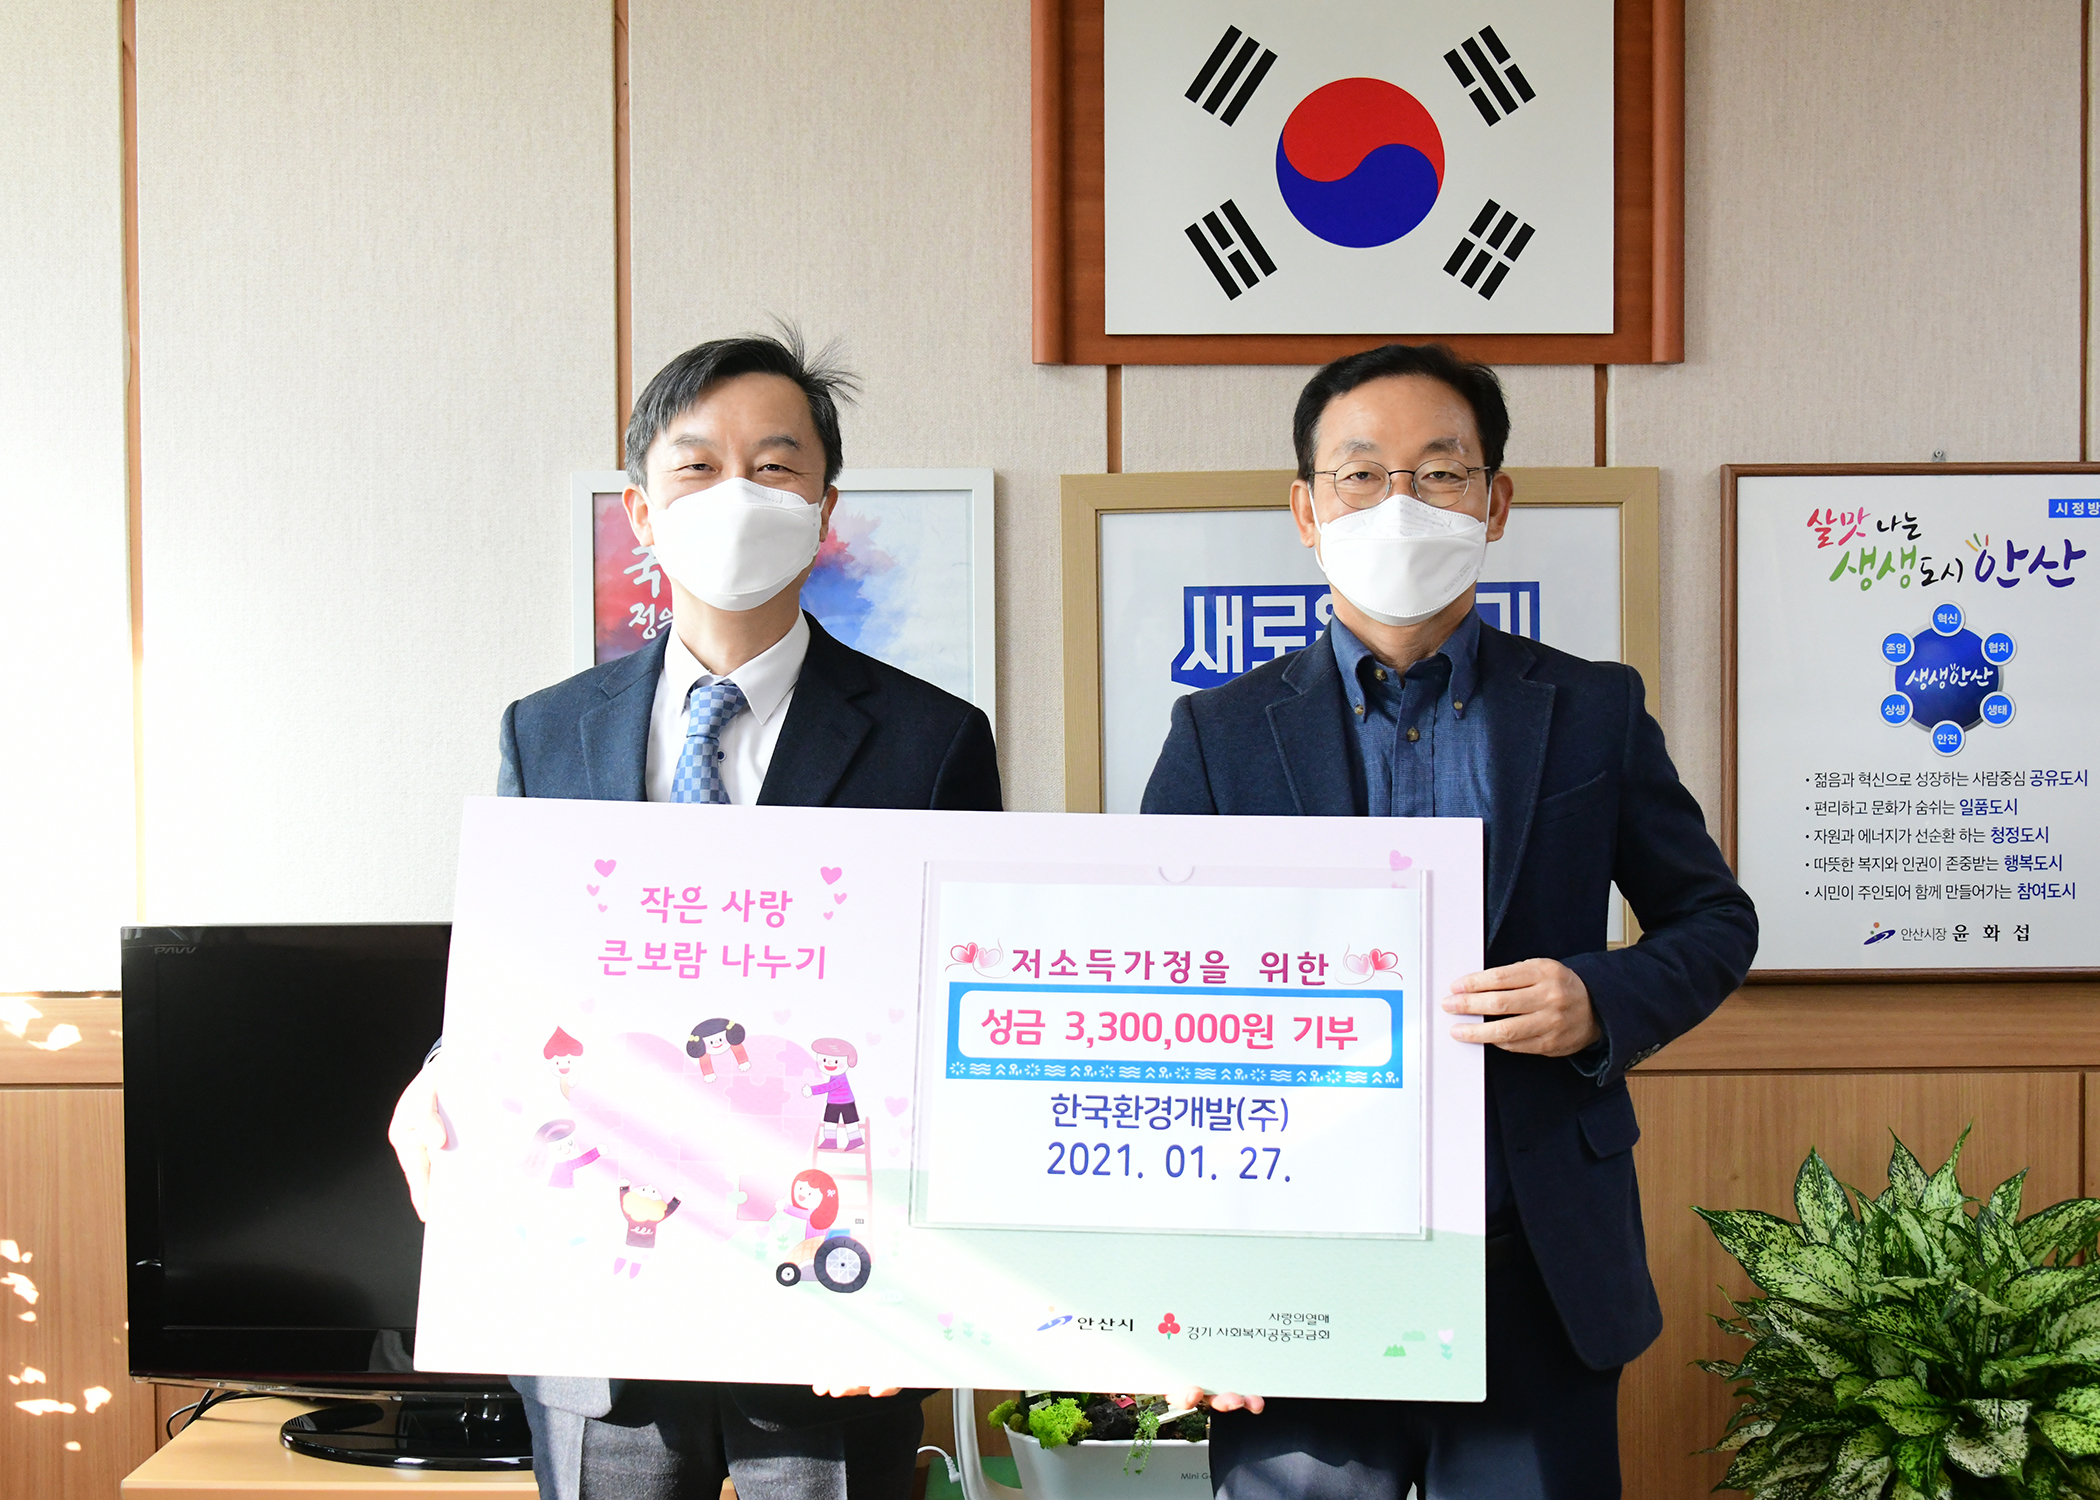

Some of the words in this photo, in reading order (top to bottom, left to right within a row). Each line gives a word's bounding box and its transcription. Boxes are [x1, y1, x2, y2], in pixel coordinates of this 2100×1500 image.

[2055, 501, 2100, 516] 시정방
[1974, 538, 2087, 588] 안산
[1937, 612, 1958, 626] 혁신
[1180, 593, 1333, 674] 새로
[1885, 641, 1906, 655] 존엄
[1987, 641, 2009, 655] 협치
[1905, 665, 1994, 690] 생생안산
[1884, 703, 1906, 717] 상생
[1986, 703, 2008, 717] 생태
[1936, 732, 1958, 746] 안전
[1814, 771, 1855, 788] 젊음과
[1858, 771, 1912, 788] 혁신으로
[1915, 771, 1969, 788] 성장하는
[1972, 770, 2026, 787] 사람중심
[2029, 769, 2088, 787] 공유도시
[1814, 800, 1868, 817] 편리하고
[1871, 800, 1912, 816] 문화가
[1915, 799, 1956, 816] 숨쉬는
[1959, 798, 2018, 816] 일품도시
[1813, 828, 1855, 845] 자원과
[1857, 828, 1912, 844] 에너지가
[1915, 827, 1956, 844] 선순환
[1959, 827, 1986, 844] 하는
[1990, 826, 2049, 844] 청정도시
[1814, 856, 1855, 873] 따뜻한
[1858, 856, 1899, 872] 복지와
[1901, 856, 1942, 872] 인권이
[1945, 855, 1999, 872] 존중받는
[2004, 853, 2063, 873] 행복도시
[1813, 884, 1854, 901] 시민이
[1857, 884, 1911, 901] 주인되어
[1915, 883, 1942, 900] 함께
[1945, 883, 2012, 900] 만들어가는
[2017, 882, 2076, 900] 참여도시
[640, 885, 708, 924] 작은
[721, 888, 793, 929] 사랑
[1900, 927, 1947, 942] 안산시장
[721, 943, 826, 980] 나누기
[1011, 948, 1231, 986] 저소득가정을
[1257, 950, 1330, 987] 위한
[981, 1008, 1046, 1047] 성금
[1064, 1011, 1275, 1051] 3,300,000원
[1292, 1014, 1359, 1051] 기부
[1050, 1093, 1290, 1133] 한국환경개발(주)
[1046, 1141, 1145, 1180] 2021.
[1164, 1143, 1218, 1181] 01.
[1238, 1146, 1292, 1183] 27.
[1077, 1317, 1134, 1332] 안산시
[1268, 1312, 1330, 1326] 사랑의열매
[1187, 1326, 1212, 1340] 경기
[1216, 1327, 1330, 1343] 사회복지공동모금회
[1180, 1472, 1200, 1480] Mini
